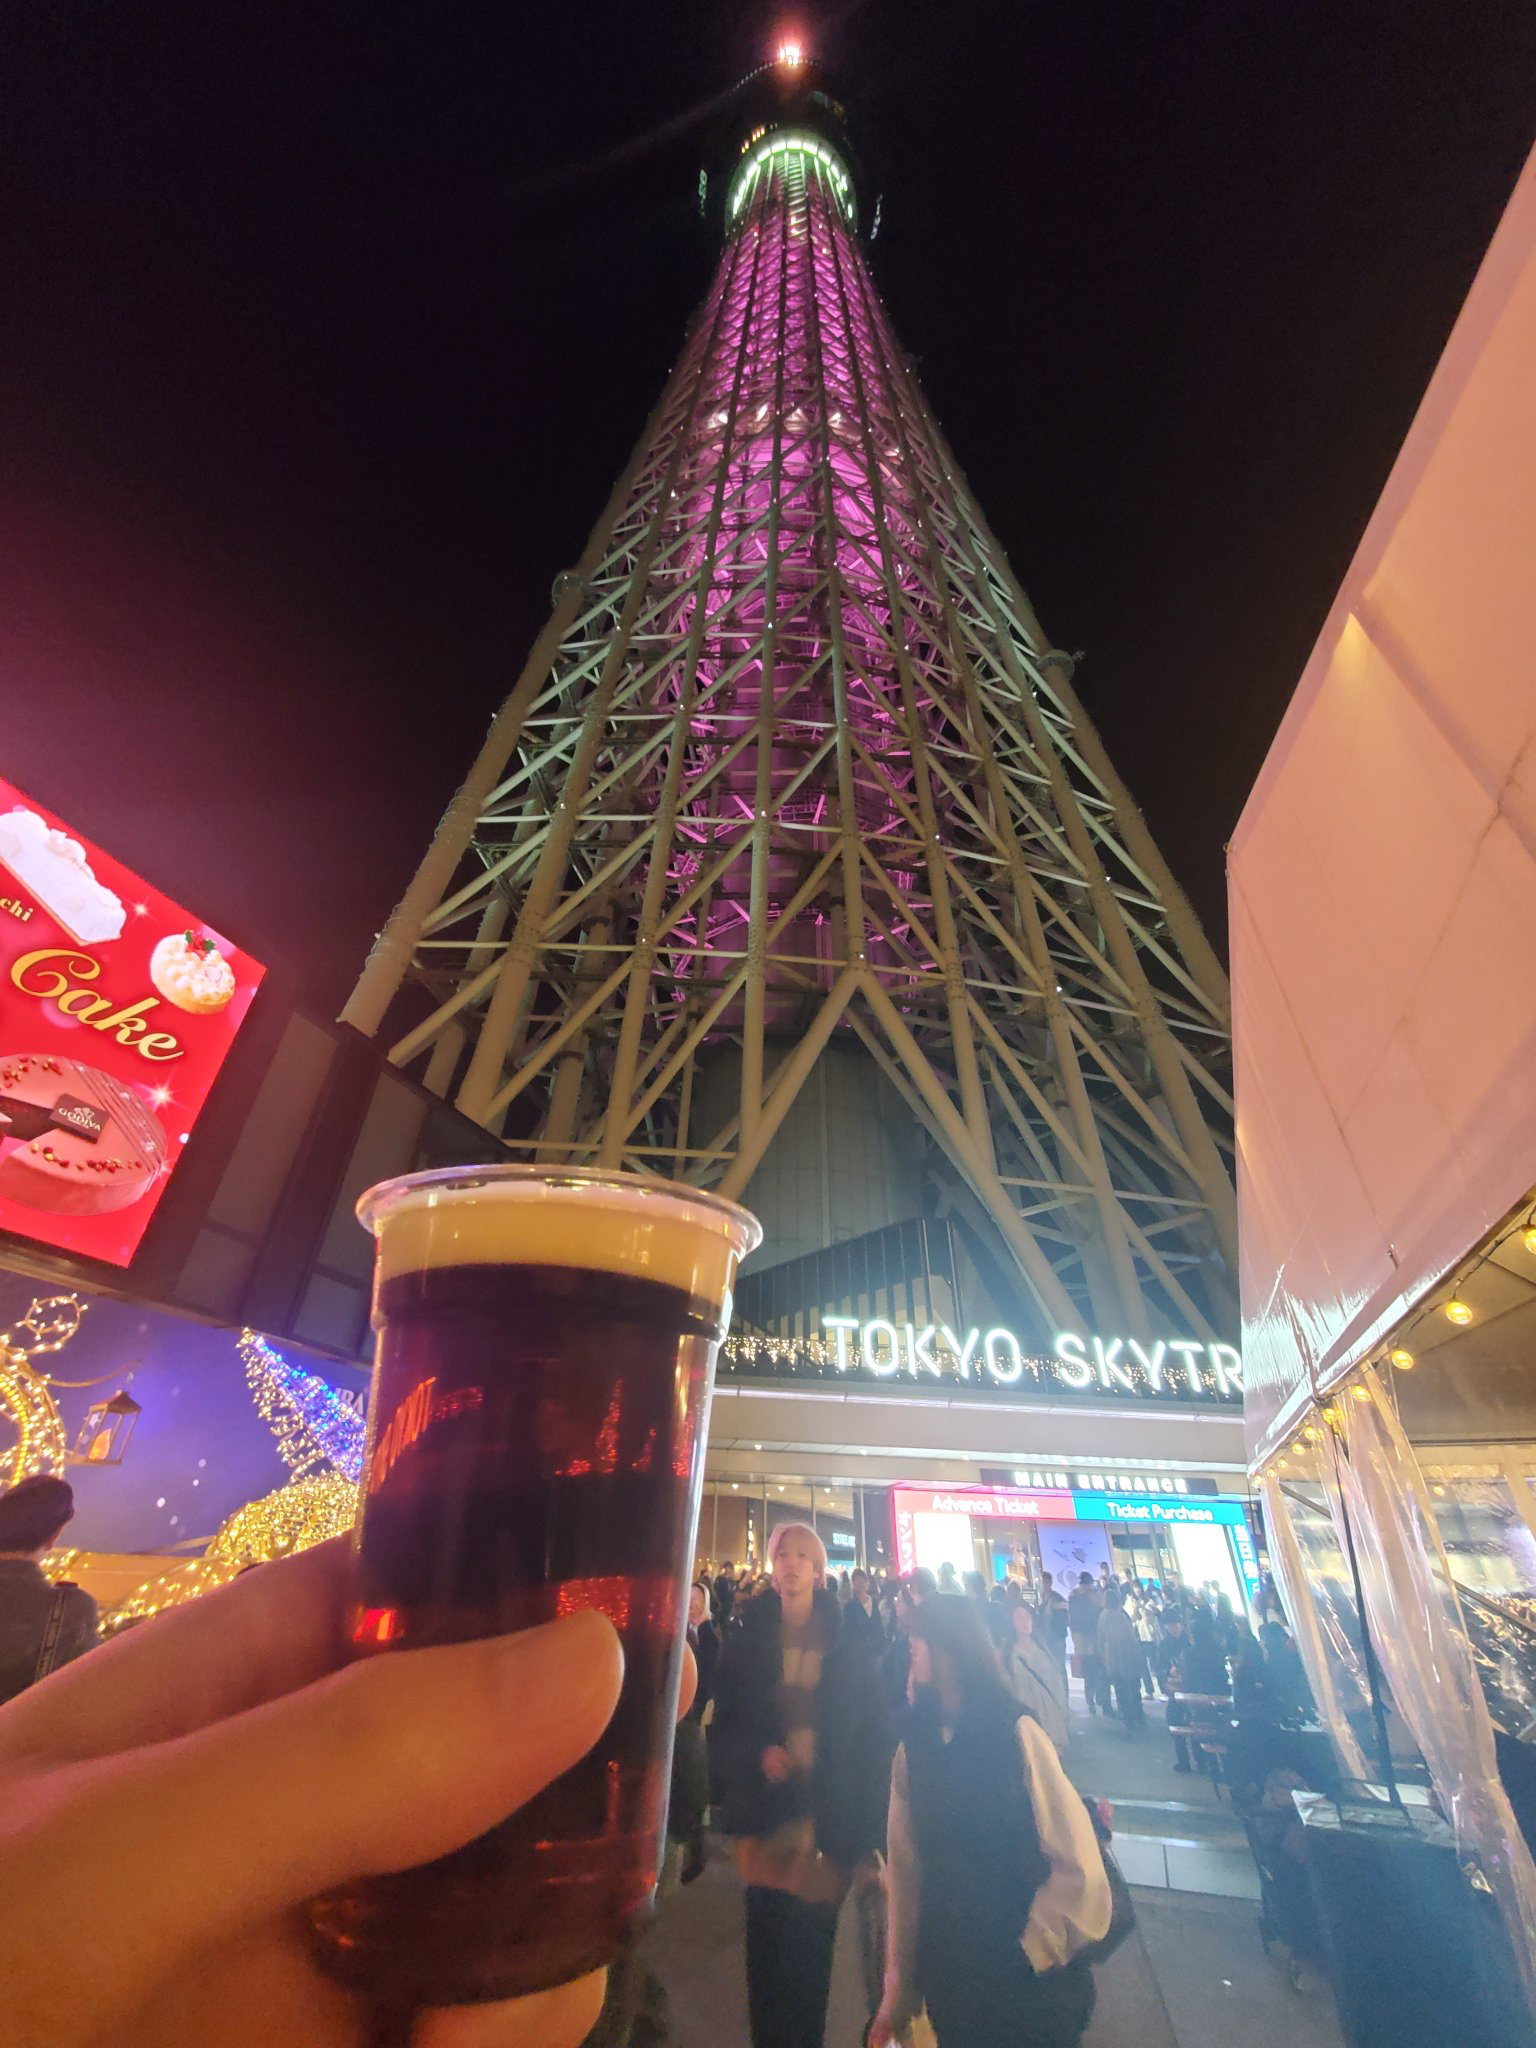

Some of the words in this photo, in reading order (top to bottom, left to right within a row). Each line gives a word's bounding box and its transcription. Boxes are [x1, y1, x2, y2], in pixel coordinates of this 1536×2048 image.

[11, 949, 184, 1061] Cake
[58, 1107, 101, 1132] GODIVA
[822, 1317, 1021, 1382] TOKYO
[1055, 1333, 1243, 1395] SKYTR
[1015, 1471, 1068, 1488] MAIN
[1078, 1474, 1188, 1493] ENTRANCE
[932, 1494, 994, 1514] Advance
[995, 1497, 1040, 1515] Ticket
[1106, 1502, 1152, 1520] Ticket
[1153, 1503, 1213, 1521] Purchase
